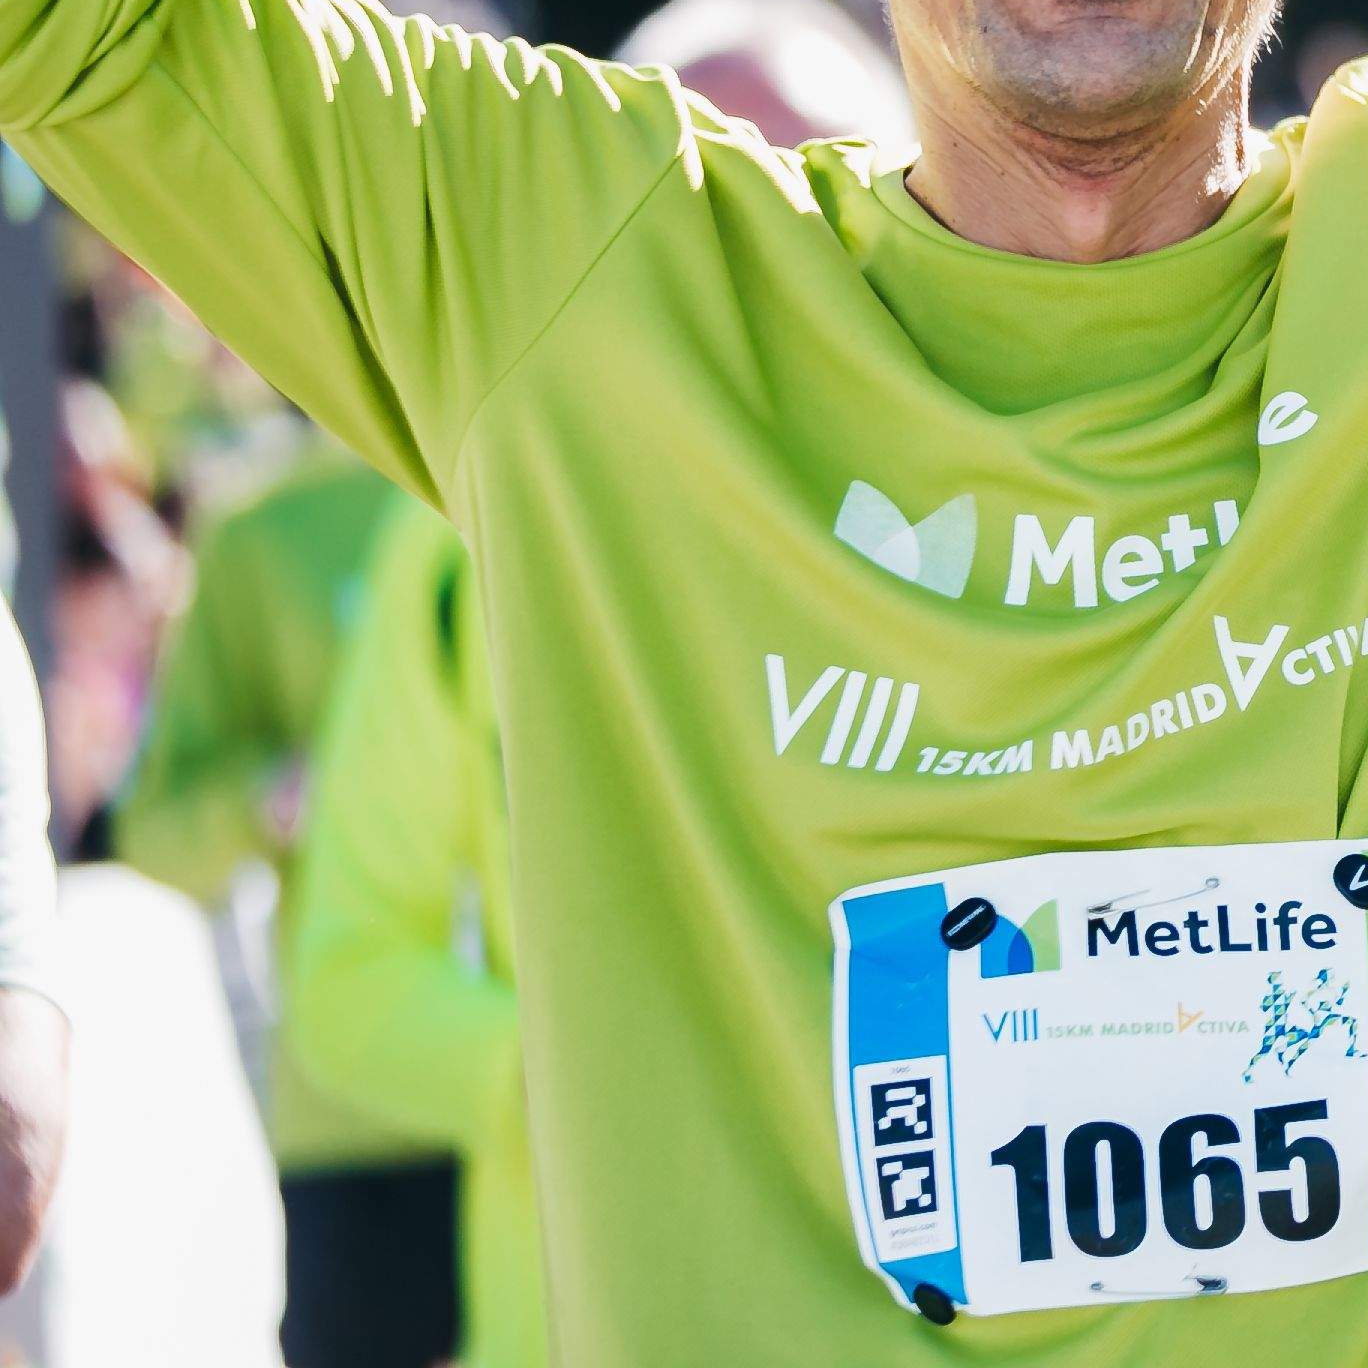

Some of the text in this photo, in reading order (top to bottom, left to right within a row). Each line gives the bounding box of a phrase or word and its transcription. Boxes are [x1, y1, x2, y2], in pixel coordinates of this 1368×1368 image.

[764, 653, 920, 772] VIII
[916, 738, 1034, 777] 15KM
[1049, 682, 1226, 771] MADRID
[1085, 899, 1339, 958] MetLife
[982, 1007, 1041, 1044] VIII
[1101, 1021, 1176, 1037] MADRID
[990, 1098, 1341, 1264] 1065
